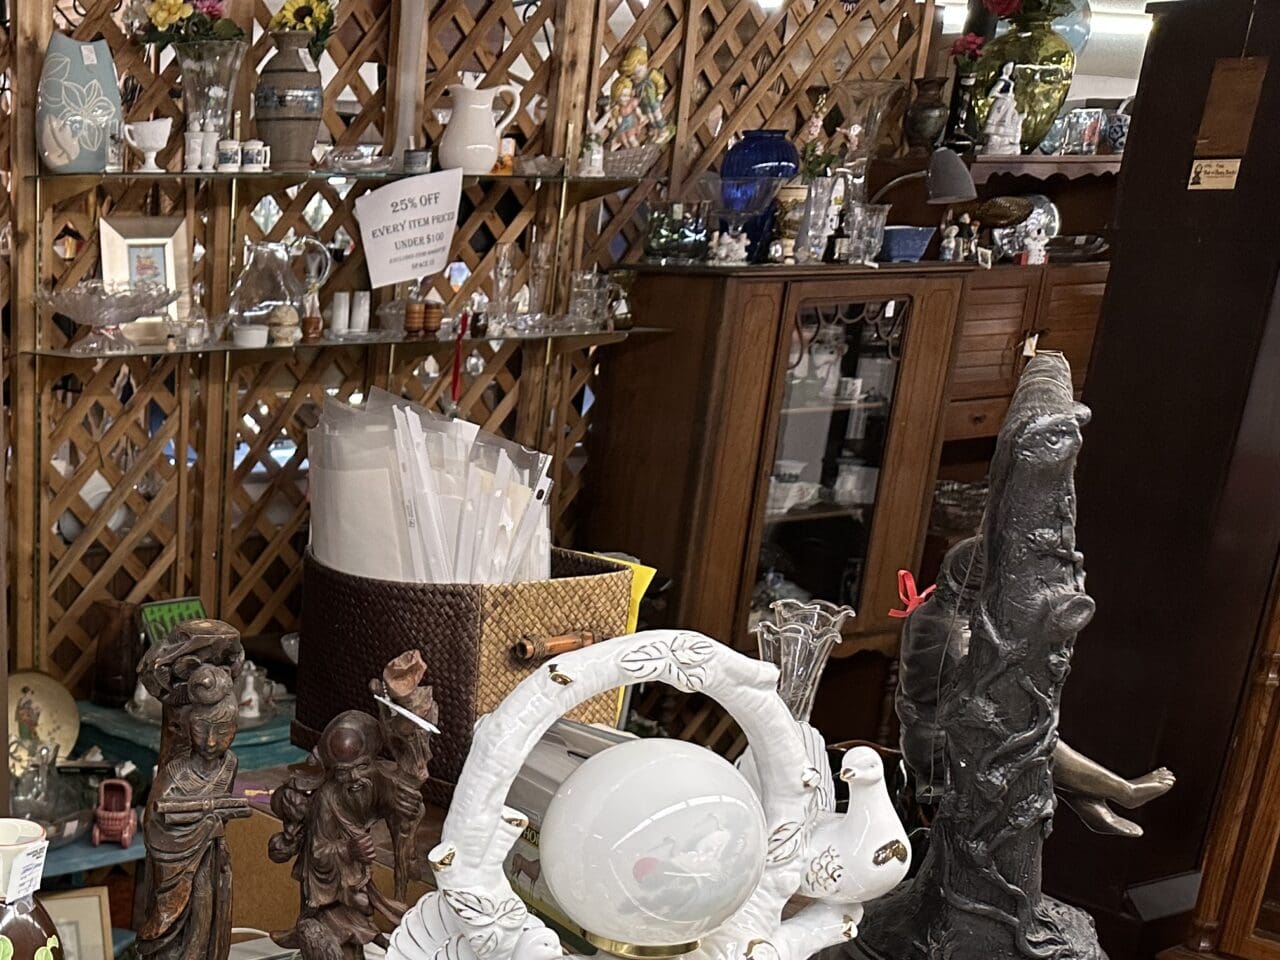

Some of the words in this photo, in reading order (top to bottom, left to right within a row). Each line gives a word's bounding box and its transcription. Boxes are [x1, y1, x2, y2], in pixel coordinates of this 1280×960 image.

[390, 196, 417, 213] 25%
[419, 192, 440, 207] OFF
[371, 220, 407, 239] EVERY
[408, 216, 430, 229] ITEM
[394, 236, 425, 250] UNDER
[426, 232, 445, 245] $100
